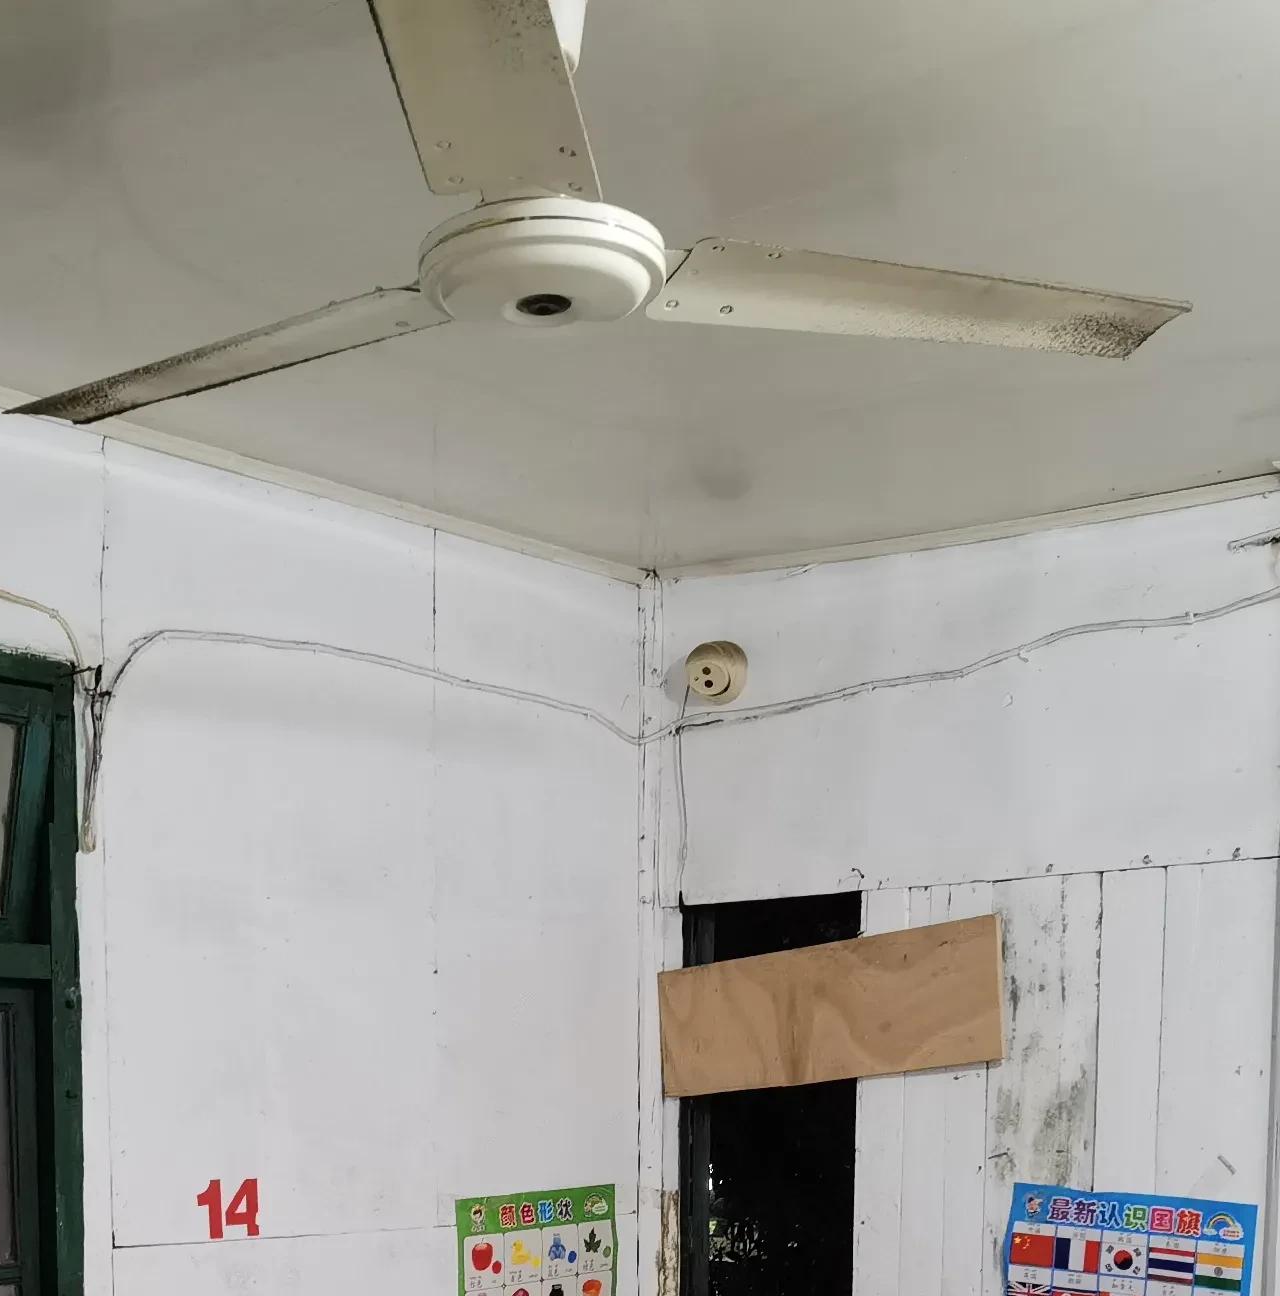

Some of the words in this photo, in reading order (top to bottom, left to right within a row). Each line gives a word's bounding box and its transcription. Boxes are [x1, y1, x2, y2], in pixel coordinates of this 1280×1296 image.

[196, 1178, 260, 1239] 14
[500, 1197, 573, 1228] 颜色形状
[1048, 1196, 1203, 1236] 最新认识国旗
